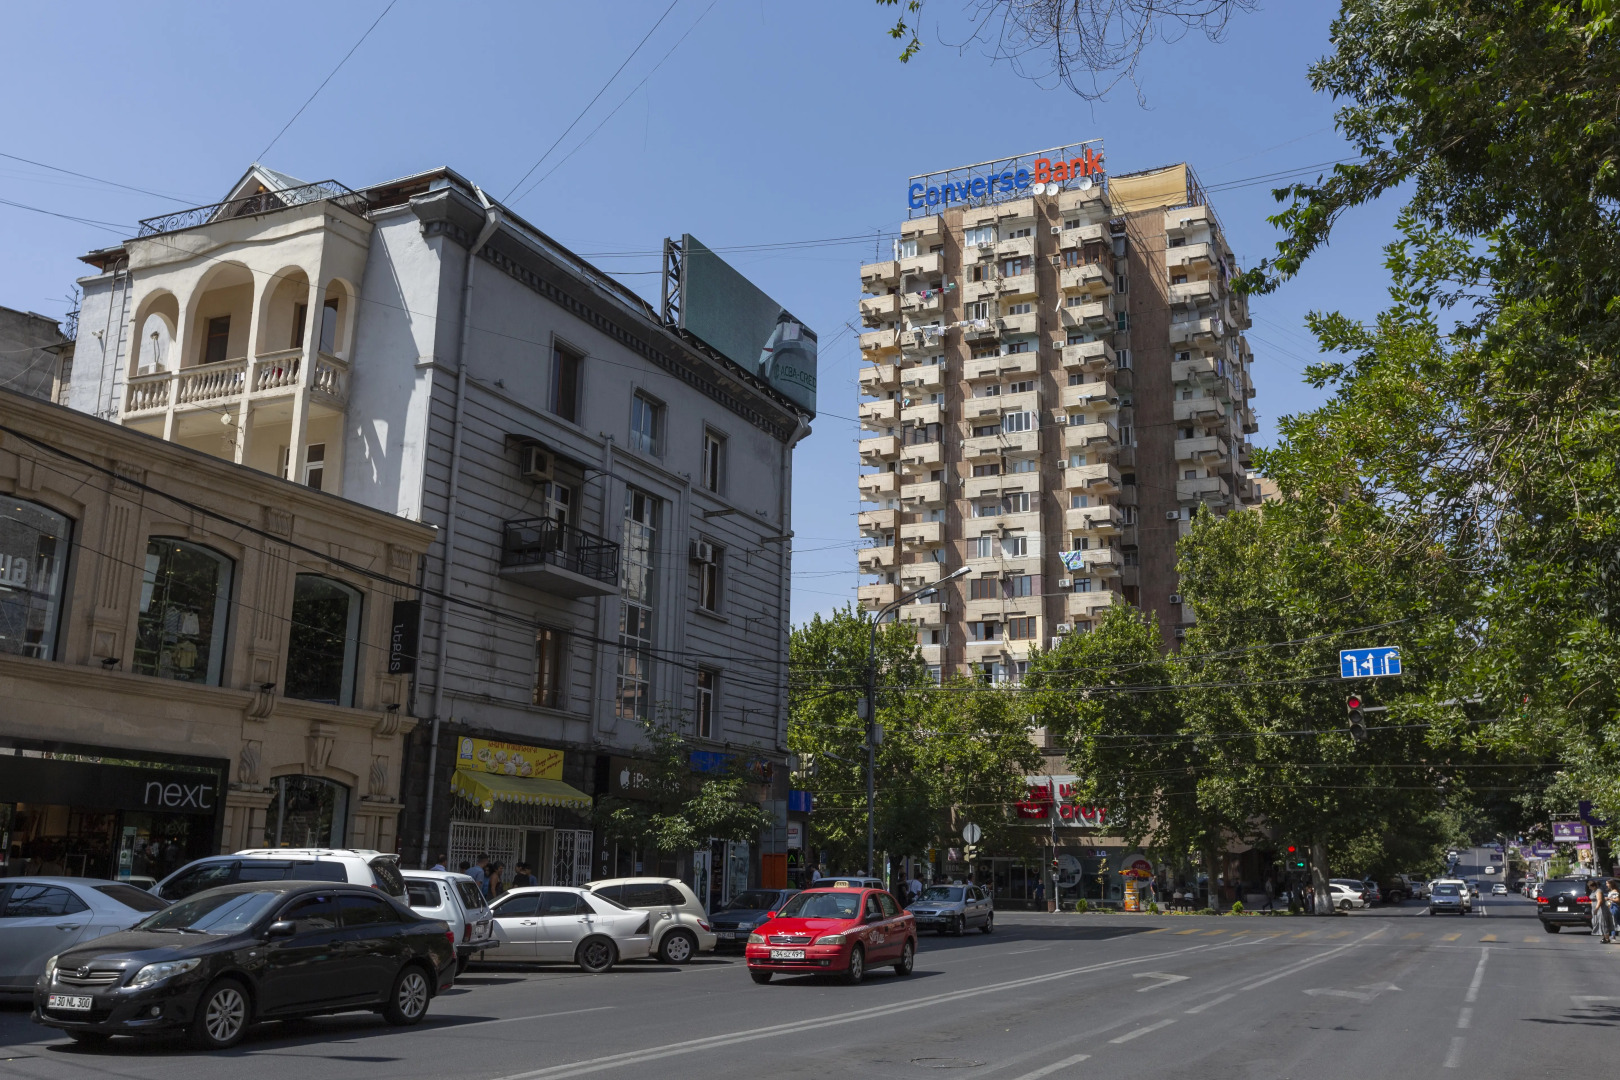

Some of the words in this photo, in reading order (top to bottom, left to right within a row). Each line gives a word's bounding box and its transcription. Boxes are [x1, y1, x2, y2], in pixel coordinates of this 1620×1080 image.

[908, 167, 1030, 210] Converse
[1033, 148, 1104, 185] Bank
[143, 780, 213, 809] next
[56, 996, 65, 1007] 30
[66, 997, 75, 1007] NL
[77, 997, 91, 1008] 300
